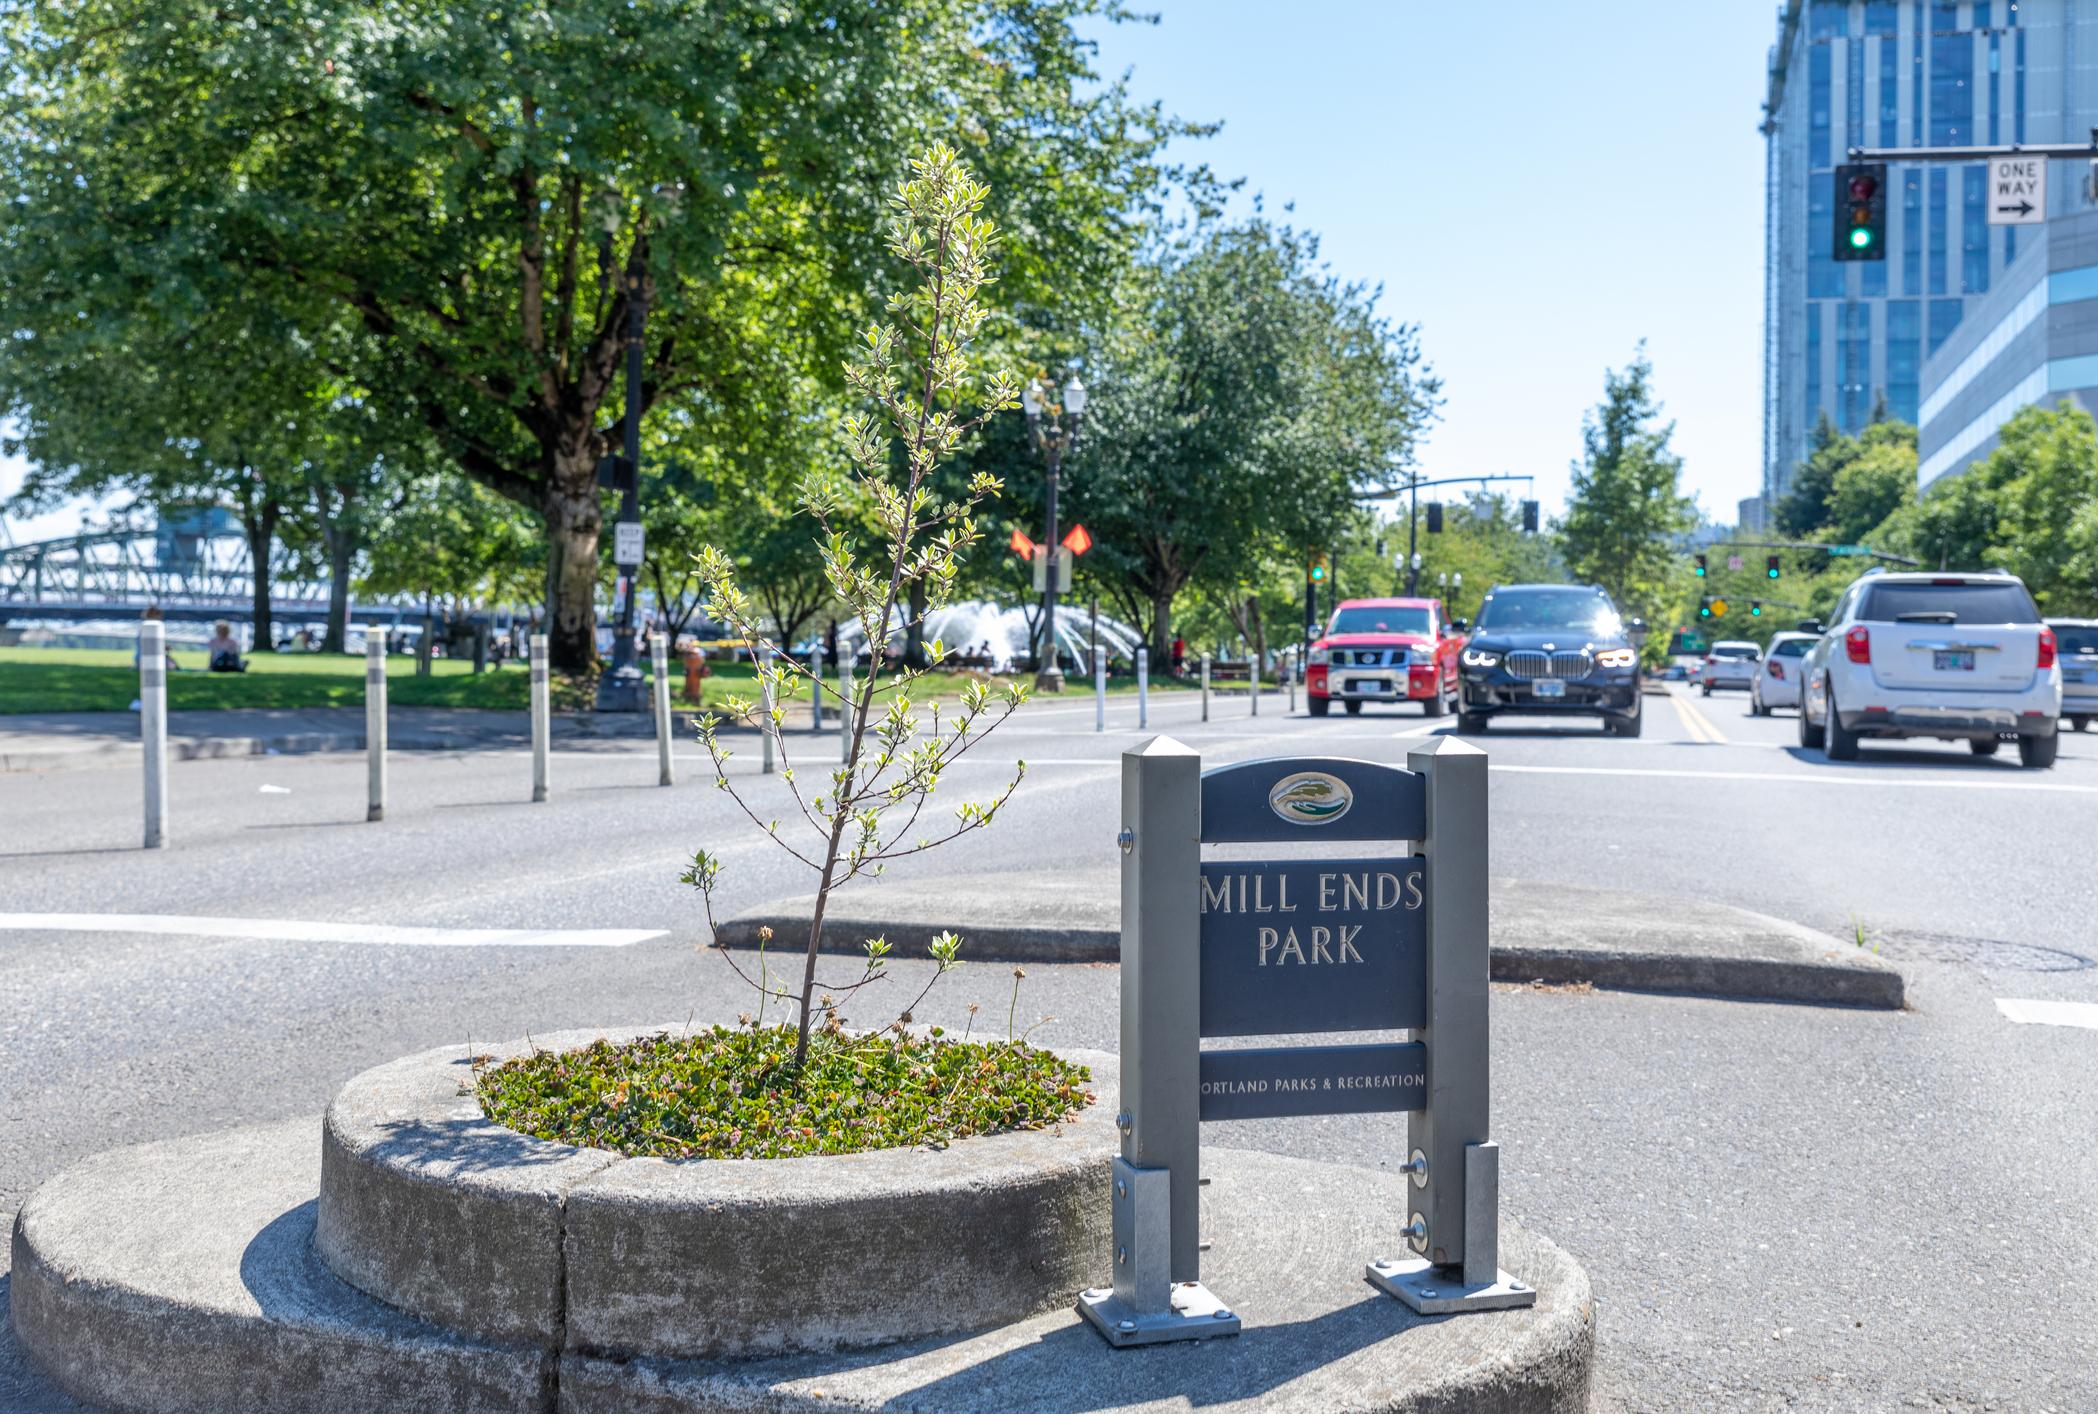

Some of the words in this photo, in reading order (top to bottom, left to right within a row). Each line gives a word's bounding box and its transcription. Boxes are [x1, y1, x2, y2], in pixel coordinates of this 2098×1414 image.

[1999, 162, 2037, 178] ONE
[1997, 180, 2038, 195] WAY
[1200, 874, 1298, 914] MILL
[1318, 871, 1423, 912] ENDS
[1258, 925, 1365, 966] PARK
[1200, 1080, 1268, 1095] ORTLAND
[1275, 1078, 1317, 1092] PARKS
[1323, 1078, 1331, 1090] &
[1338, 1074, 1425, 1090] RECREATION
